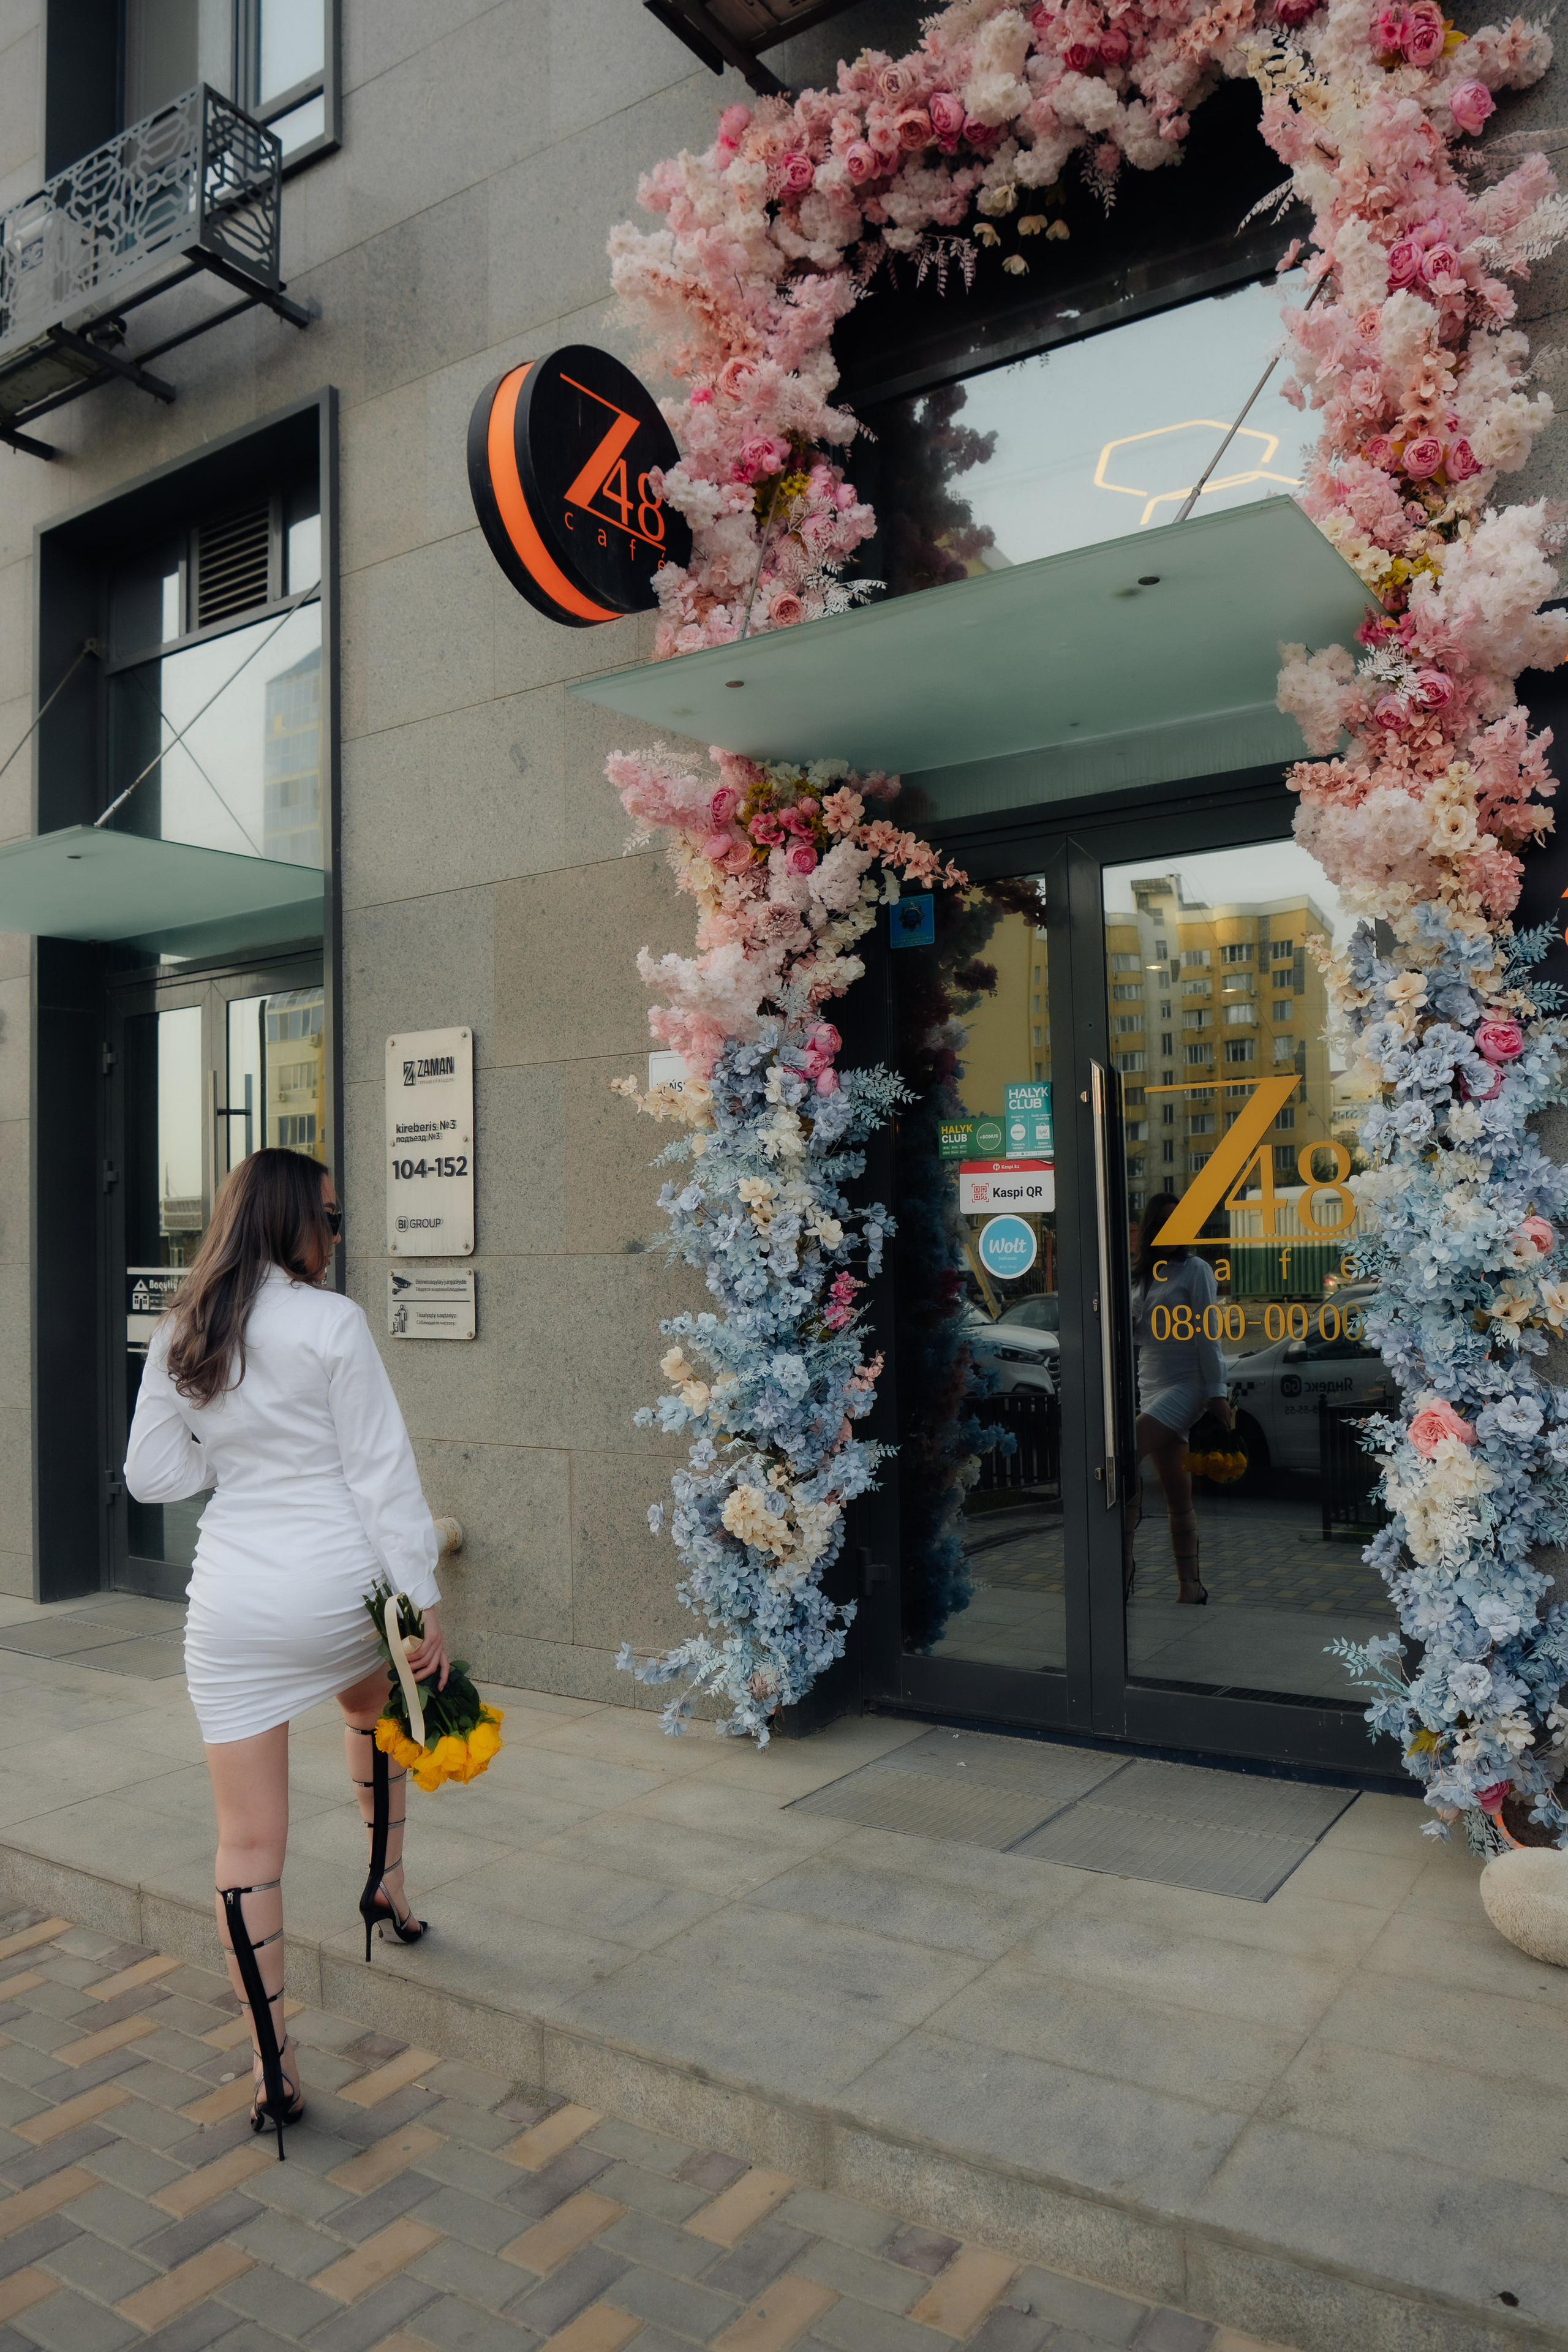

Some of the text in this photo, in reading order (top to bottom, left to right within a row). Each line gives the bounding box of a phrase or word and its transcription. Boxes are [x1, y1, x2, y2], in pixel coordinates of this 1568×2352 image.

[417, 1056, 454, 1077] ZAMAN
[1009, 1087, 1048, 1099] HALYK
[1009, 1098, 1042, 1110] CLUB
[396, 1121, 437, 1134] kireberis
[941, 1124, 973, 1134] HALYK
[941, 1134, 967, 1144] CLUB
[1144, 1074, 1357, 1246] Z48
[392, 1156, 467, 1180] 104-152
[992, 1186, 1042, 1199] Kaspi QR
[398, 1218, 441, 1229] BI GROUP
[989, 1237, 1027, 1254] Wolt
